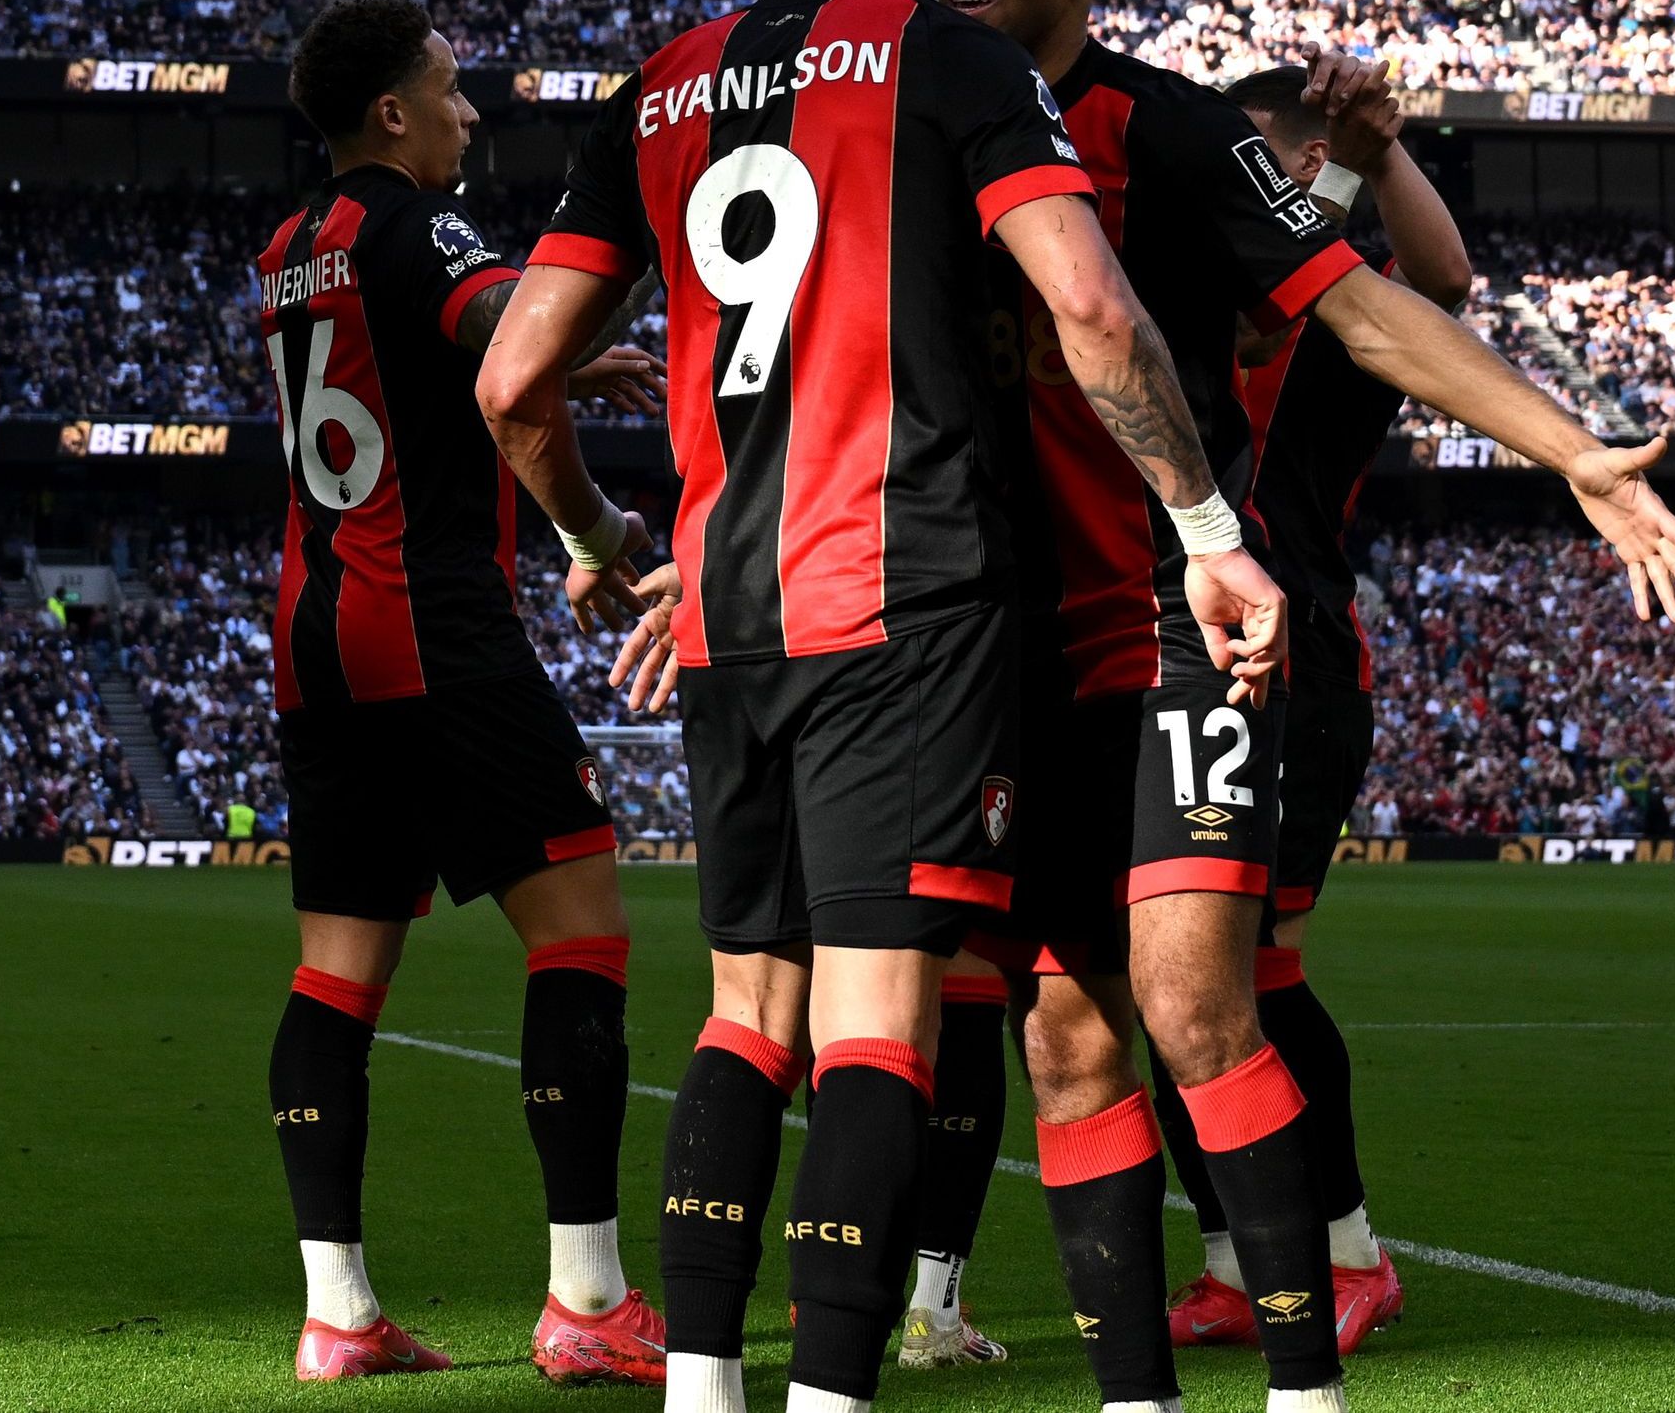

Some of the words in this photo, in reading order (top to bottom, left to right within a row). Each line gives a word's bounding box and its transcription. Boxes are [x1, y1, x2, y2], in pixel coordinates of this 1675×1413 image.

[93, 60, 229, 93] BETMGM
[539, 70, 634, 101] BETM
[639, 39, 892, 139] EVANILSON
[1528, 91, 1650, 123] BETMGM
[1274, 197, 1323, 233] LE
[261, 249, 351, 313] AVERNIER
[685, 143, 819, 398] 9
[89, 423, 229, 456] BETMGM
[1157, 706, 1255, 807] 12
[1190, 829, 1229, 842] umbro
[111, 840, 291, 866] BETMG
[523, 1087, 564, 1105] FCB
[665, 1195, 744, 1223] AFCB
[784, 1221, 863, 1246] AFCB
[1266, 1310, 1312, 1325] umbro
